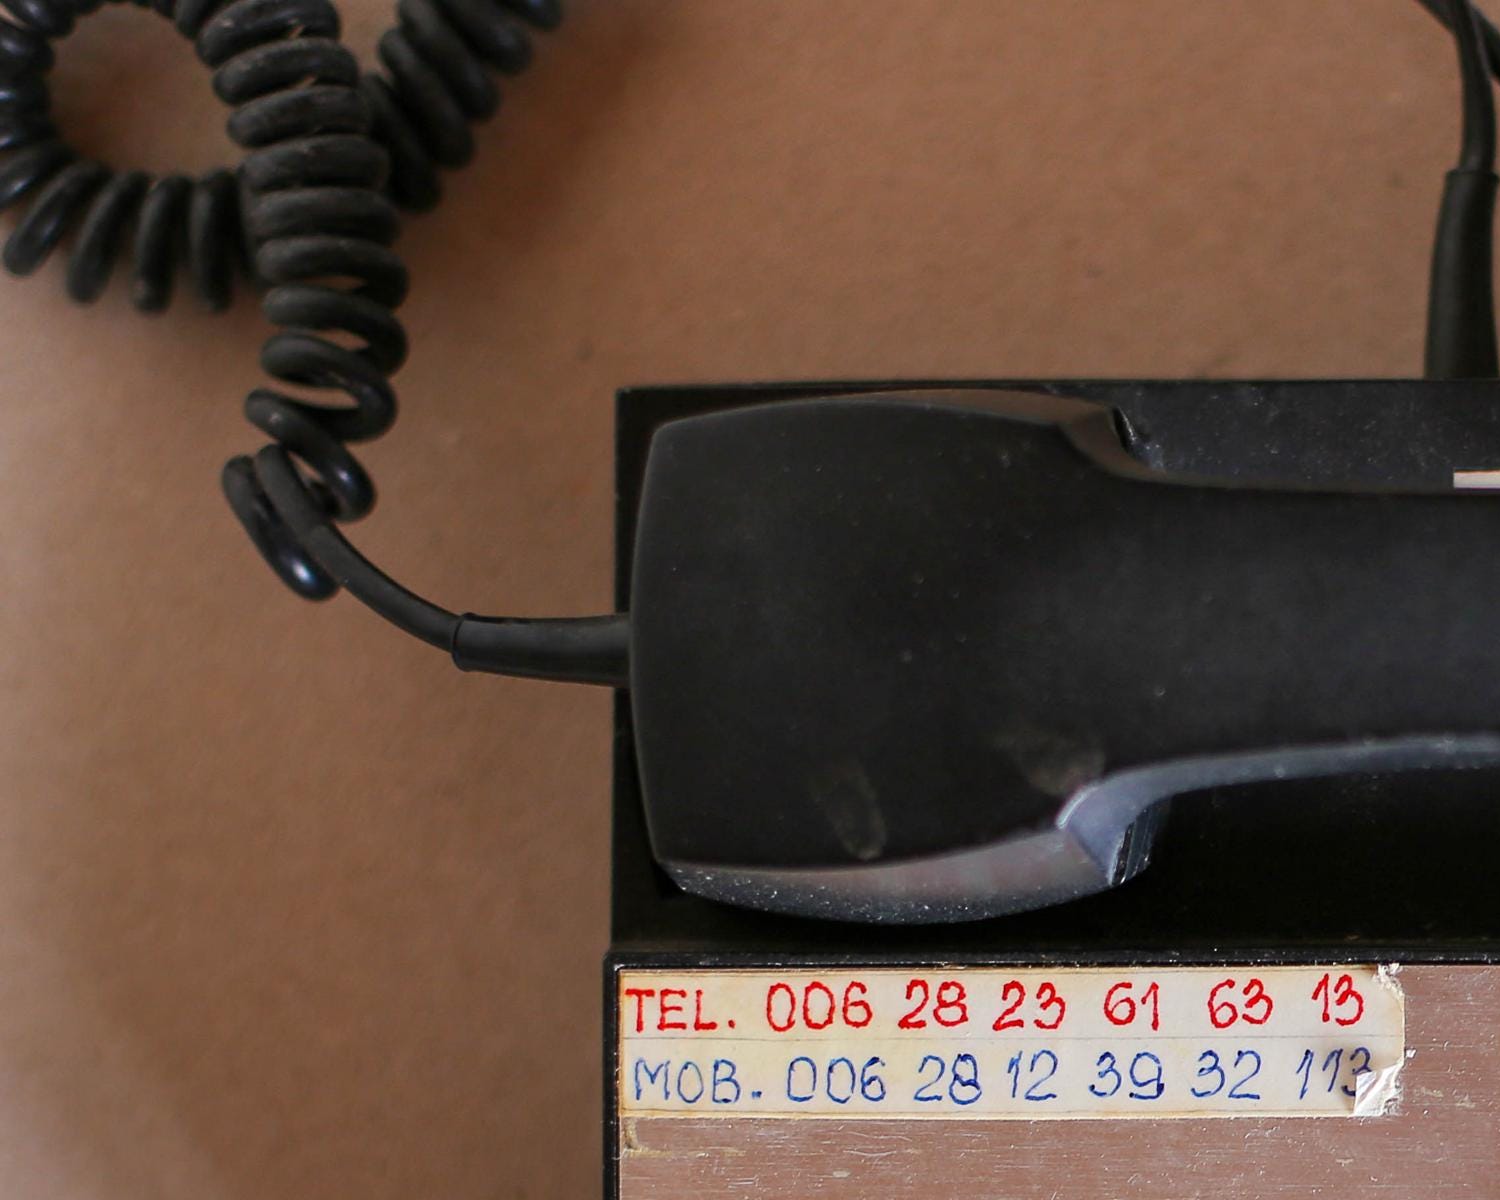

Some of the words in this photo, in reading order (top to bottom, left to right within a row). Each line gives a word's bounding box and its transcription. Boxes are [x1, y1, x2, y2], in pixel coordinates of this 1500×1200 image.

[626, 987, 736, 1033] TEL.
[765, 981, 872, 1031] 006
[897, 981, 967, 1030] 28
[992, 981, 1067, 1031] 23
[1103, 981, 1161, 1031] 61
[1208, 978, 1274, 1029] 63
[1312, 973, 1365, 1027] 13
[633, 1057, 762, 1105] MOB.
[787, 1055, 887, 1105] 006
[913, 1054, 982, 1106] 28
[1007, 1051, 1058, 1101] 12
[1088, 1051, 1165, 1101] 39
[1190, 1049, 1261, 1101] 32
[1295, 1047, 1373, 1101] 113
